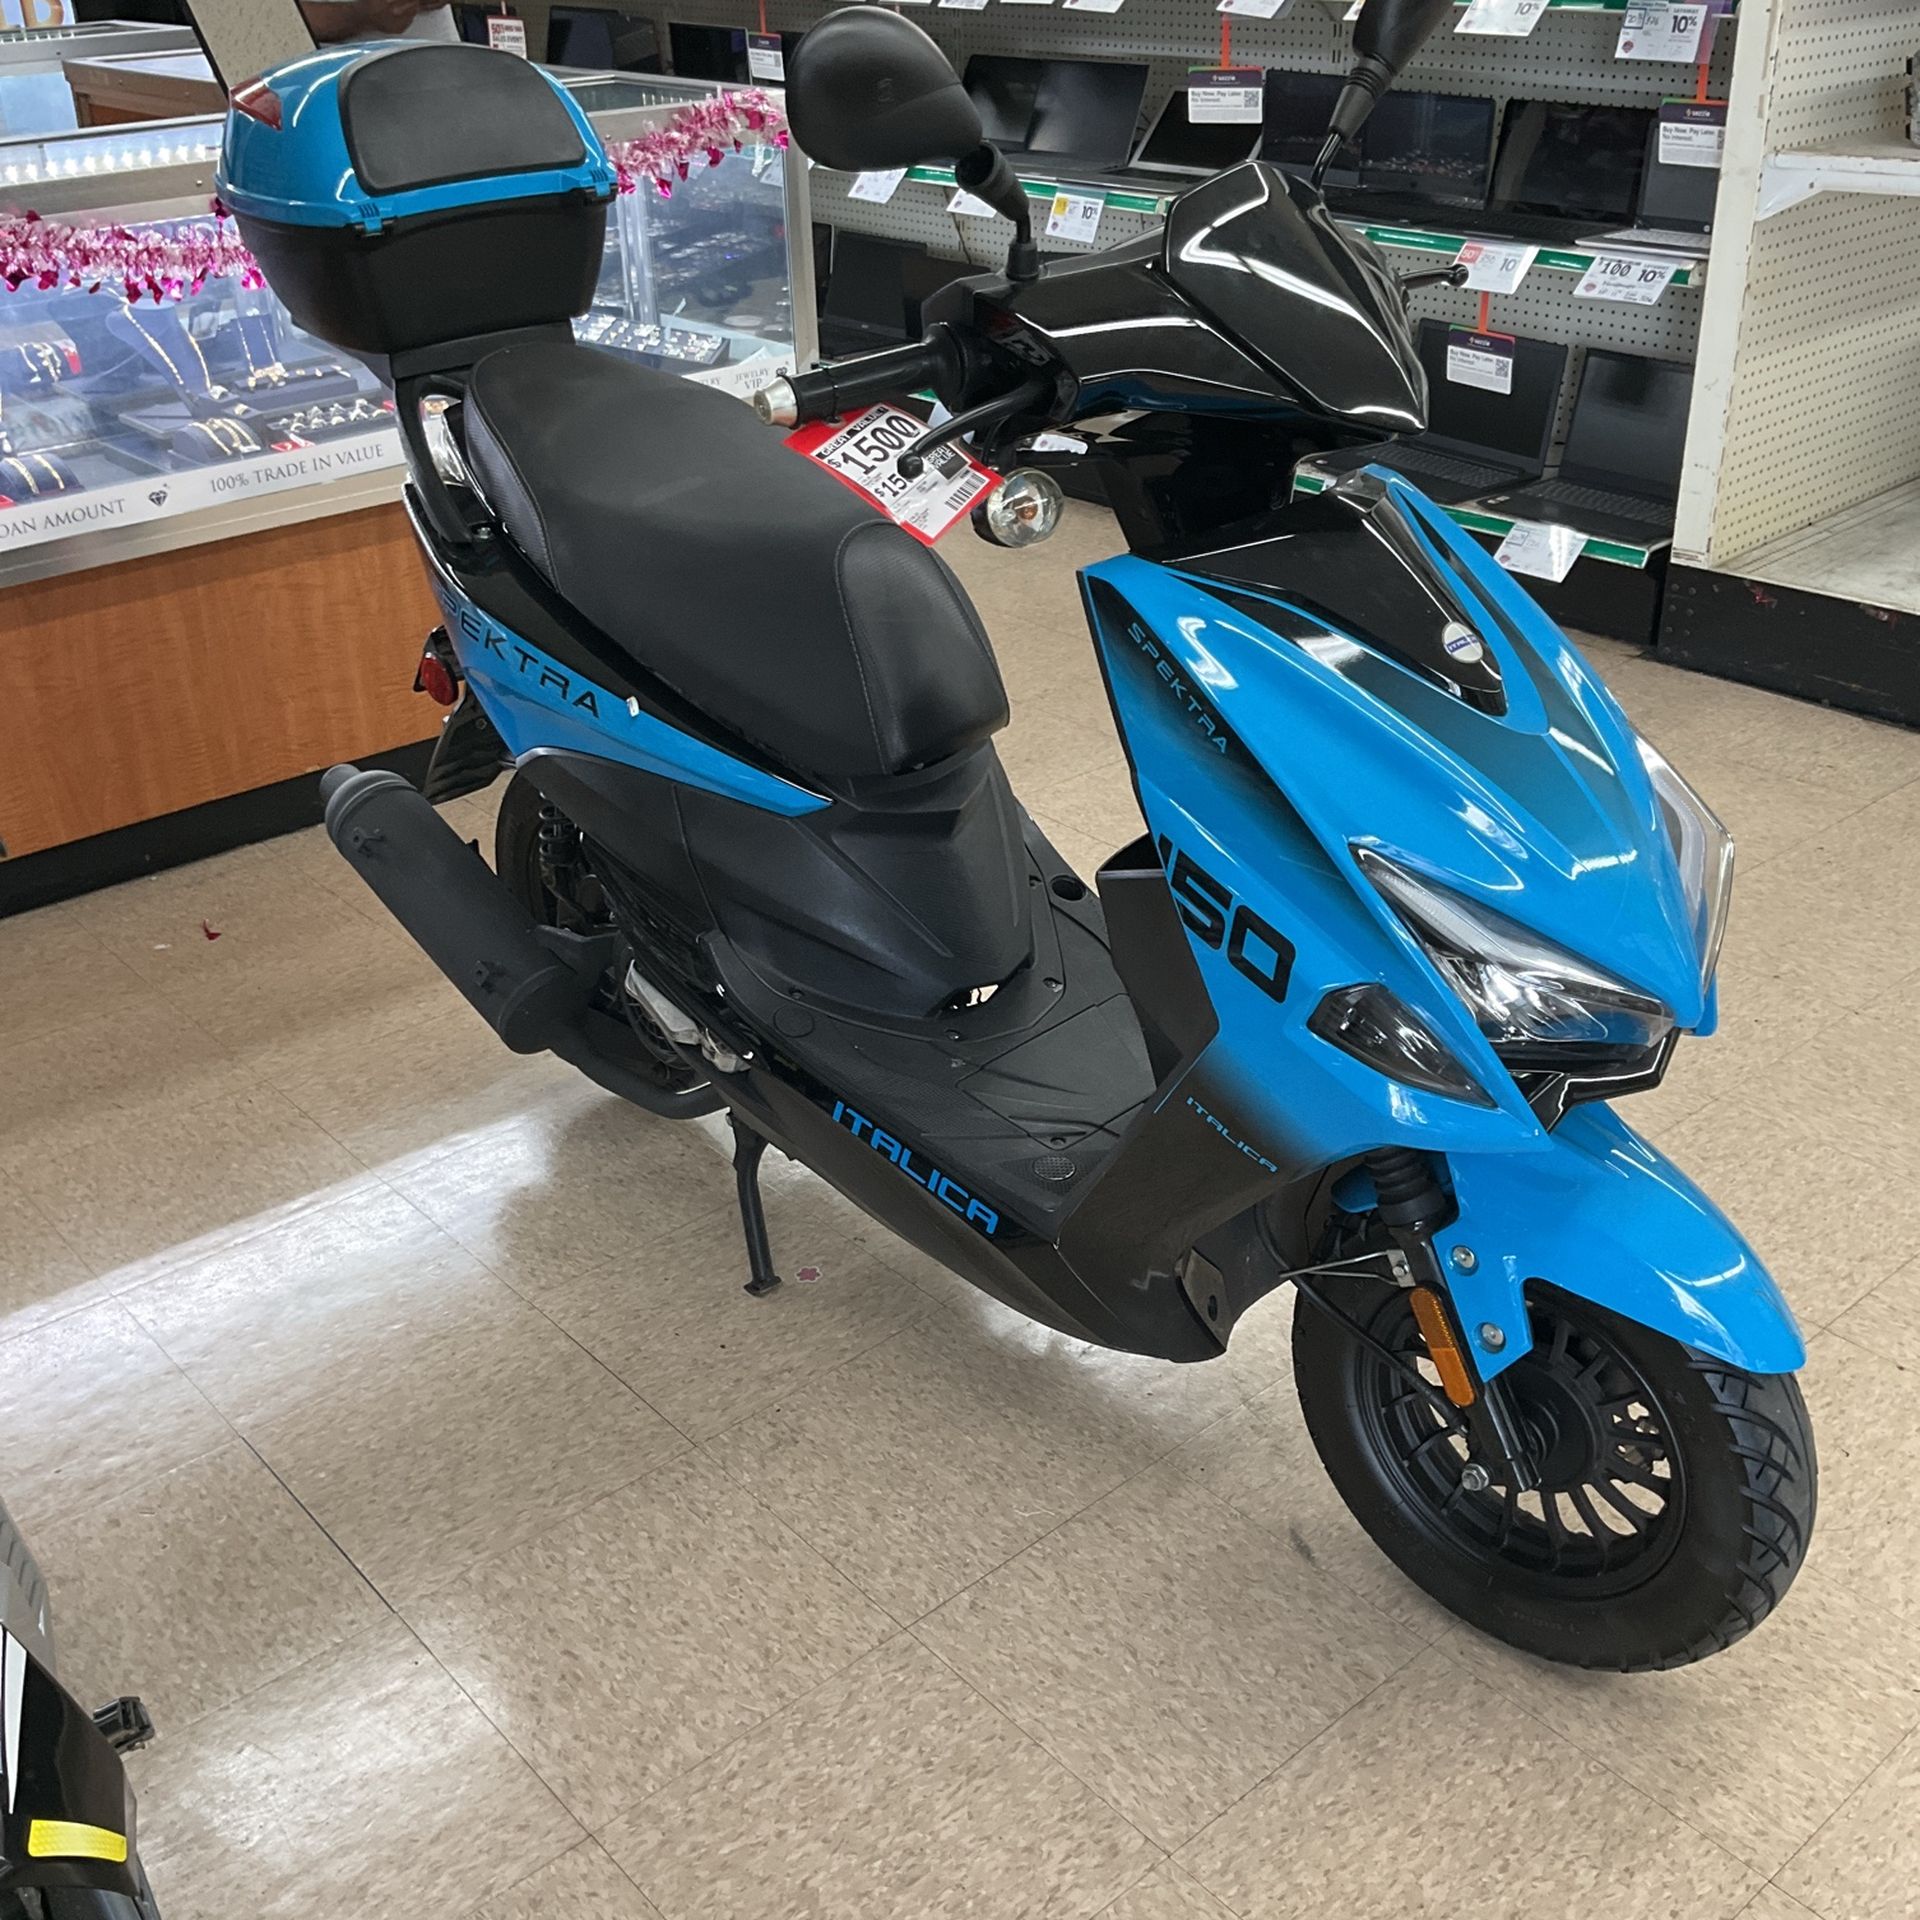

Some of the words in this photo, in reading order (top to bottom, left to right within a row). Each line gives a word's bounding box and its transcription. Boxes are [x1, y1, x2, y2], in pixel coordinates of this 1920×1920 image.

[1671, 15, 1698, 34] 10%
[1081, 205, 1098, 219] 10%
[1638, 268, 1666, 283] 10%
[734, 367, 769, 384] JEWELRY
[744, 378, 763, 390] VIP
[821, 435, 850, 457] GREAT
[827, 414, 920, 476] $1500
[210, 471, 250, 493] 100%
[253, 459, 309, 485] TRADE
[313, 454, 332, 472] IN
[335, 443, 385, 465] VALUE
[873, 473, 914, 498] $15
[43, 498, 126, 530] AMOUNT
[1127, 622, 1229, 755] SPEKTRA
[1186, 1096, 1279, 1174] ITALICA
[832, 1100, 1000, 1235] ITALICA
